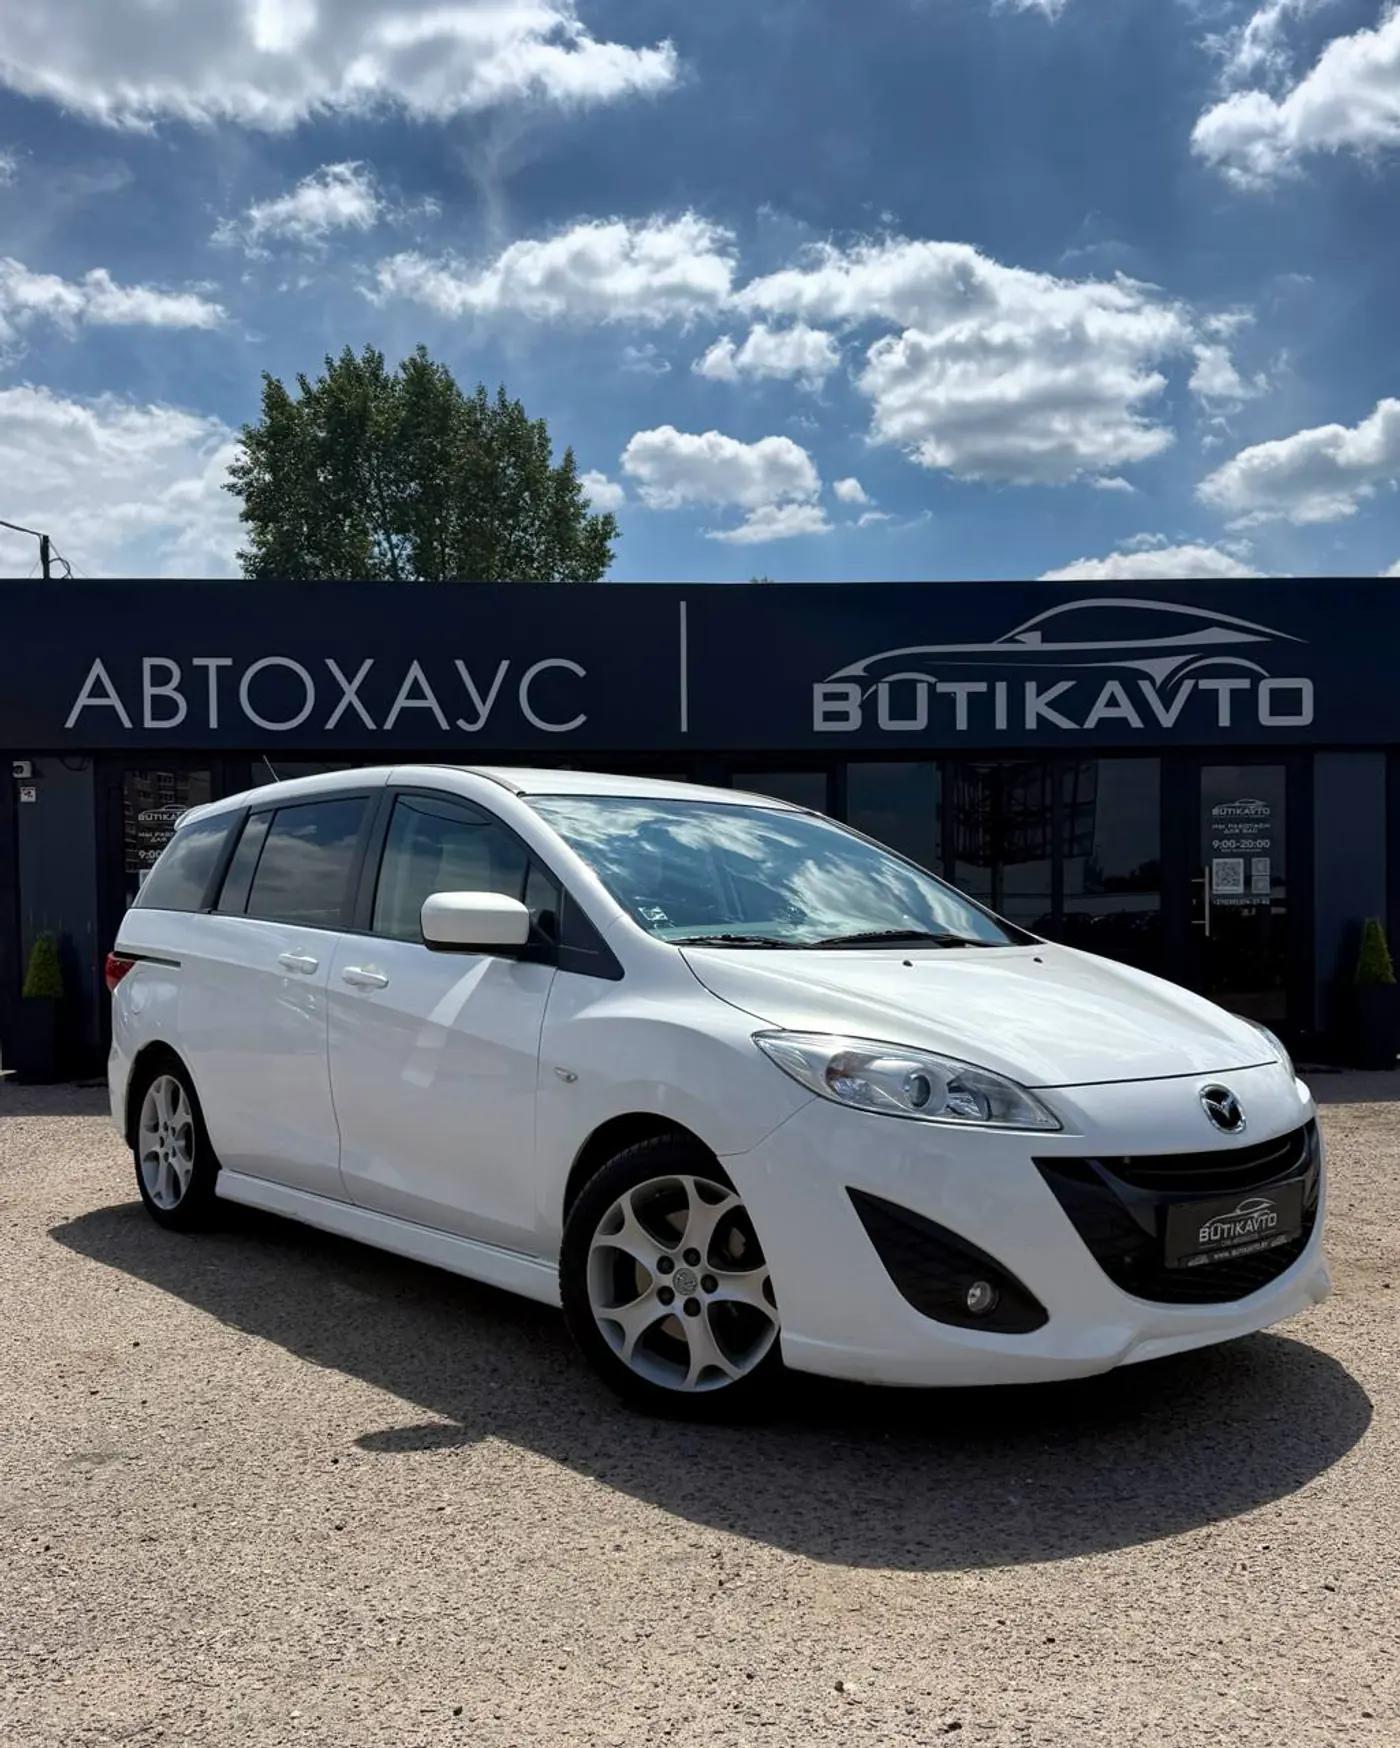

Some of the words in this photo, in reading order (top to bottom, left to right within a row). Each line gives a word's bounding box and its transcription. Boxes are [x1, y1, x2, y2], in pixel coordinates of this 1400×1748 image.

[64, 656, 588, 732] АВТОХАУС
[813, 677, 1314, 731] BUTIKAVTO
[1212, 839, 1271, 848] 9:00-20:00
[1199, 1213, 1277, 1242] BUTIKAVTO
